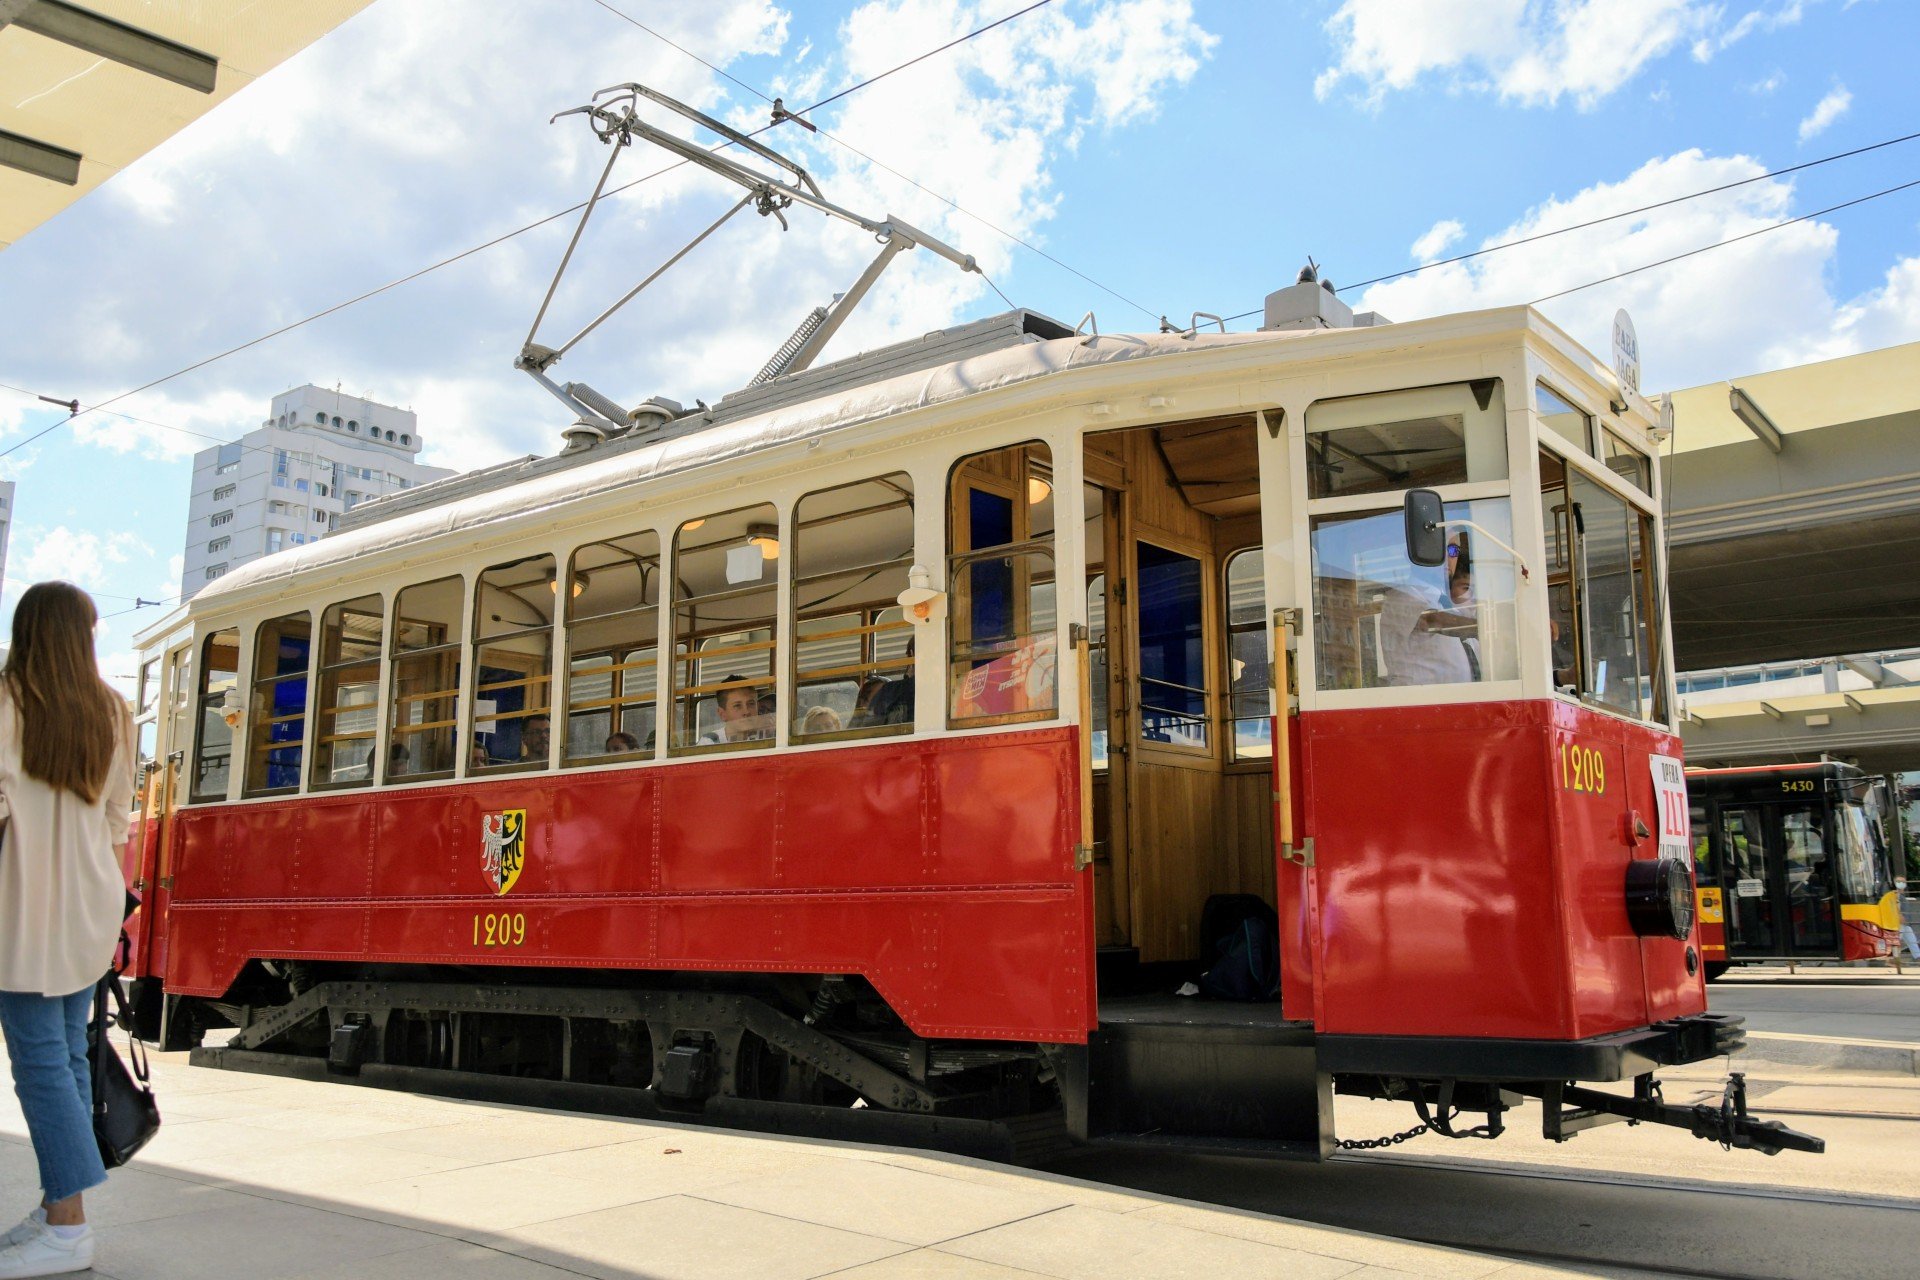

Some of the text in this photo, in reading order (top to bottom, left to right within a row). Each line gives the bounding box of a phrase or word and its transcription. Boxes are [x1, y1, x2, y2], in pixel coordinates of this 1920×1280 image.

[1616, 322, 1638, 362] BABA
[1617, 353, 1638, 391] JAGA
[1561, 743, 1605, 794] 1209
[1661, 763, 1679, 784] OPERA
[1781, 780, 1814, 792] 5430
[473, 913, 526, 946] 1209
